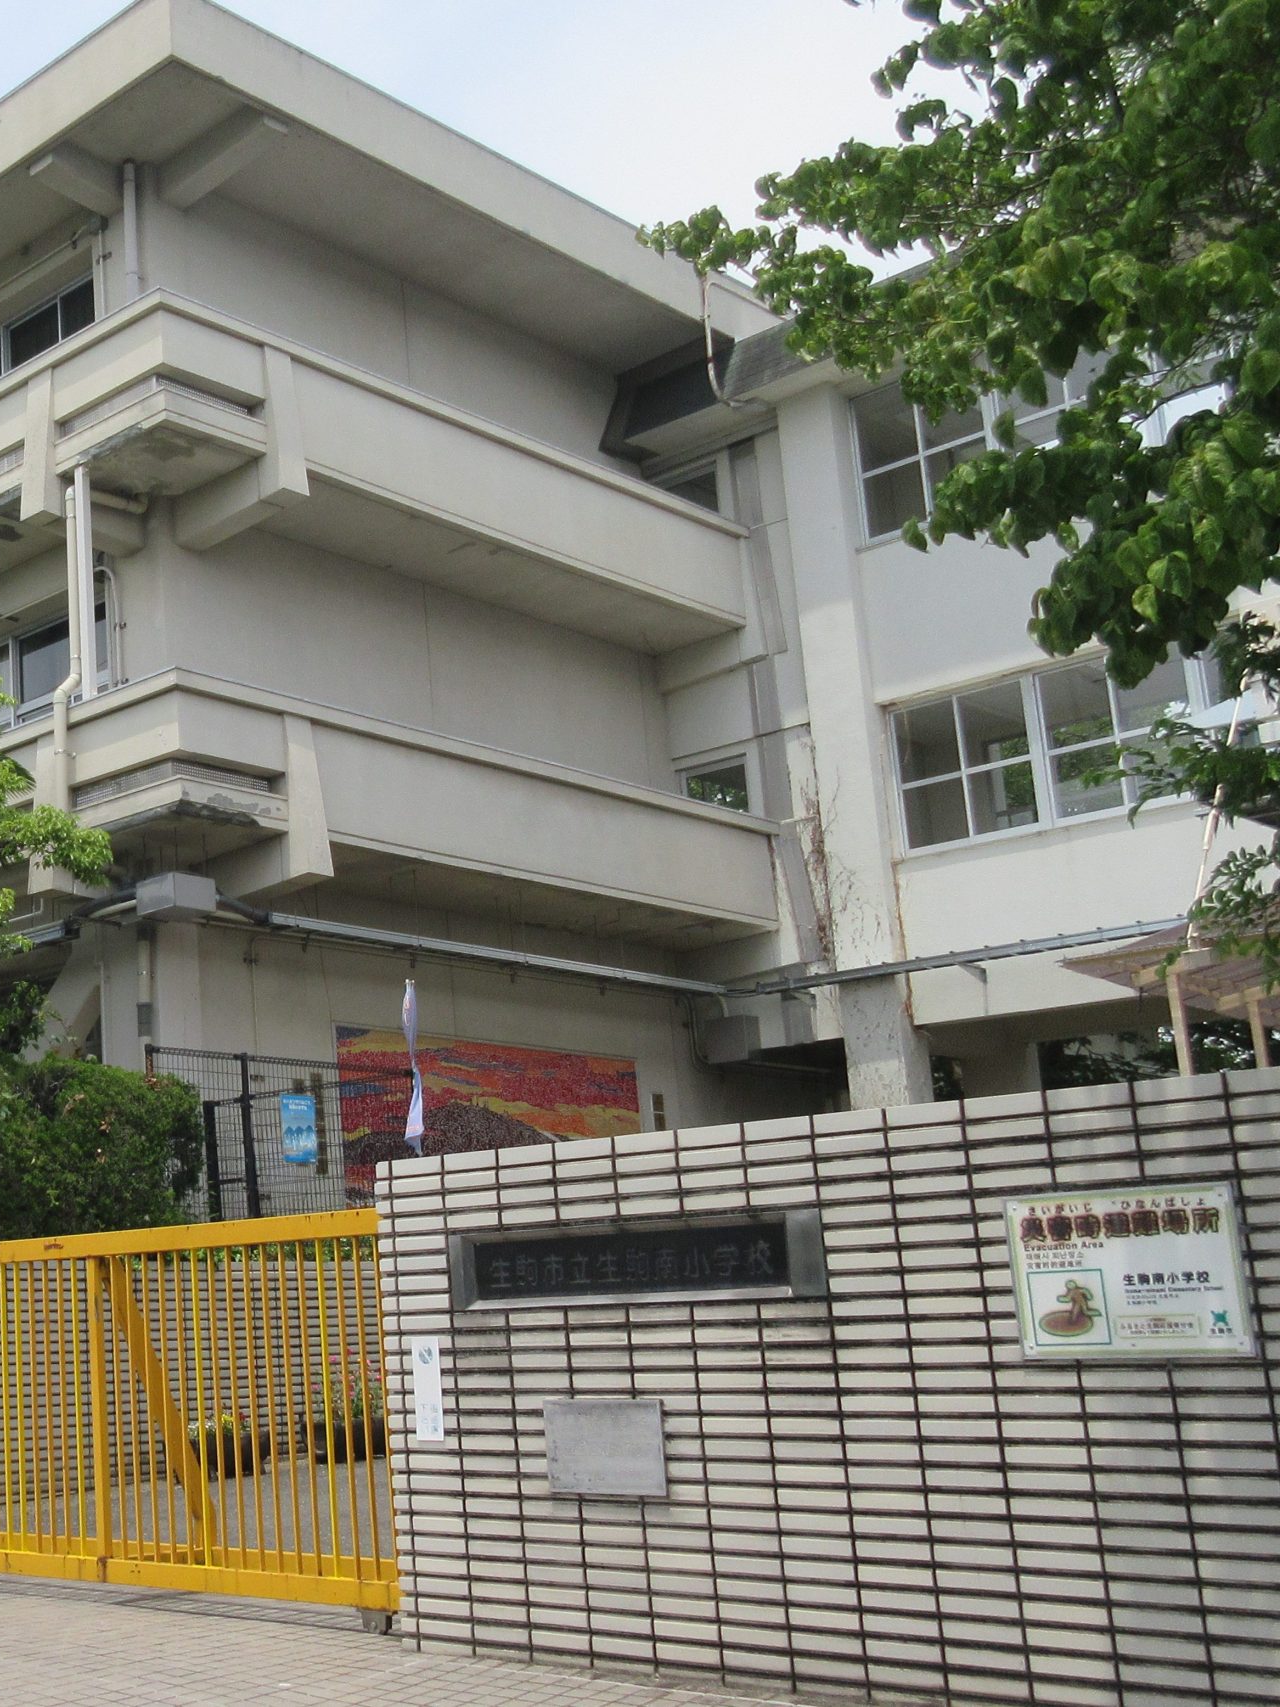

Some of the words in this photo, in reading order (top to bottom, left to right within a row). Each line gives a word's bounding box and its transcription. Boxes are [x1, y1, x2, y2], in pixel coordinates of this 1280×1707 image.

[1024, 1242, 1078, 1252] Evacuation
[1081, 1241, 1104, 1249] Area
[488, 1239, 775, 1288] 生駒市立生駒南小学校
[1123, 1270, 1210, 1286] 生駒南小学校
